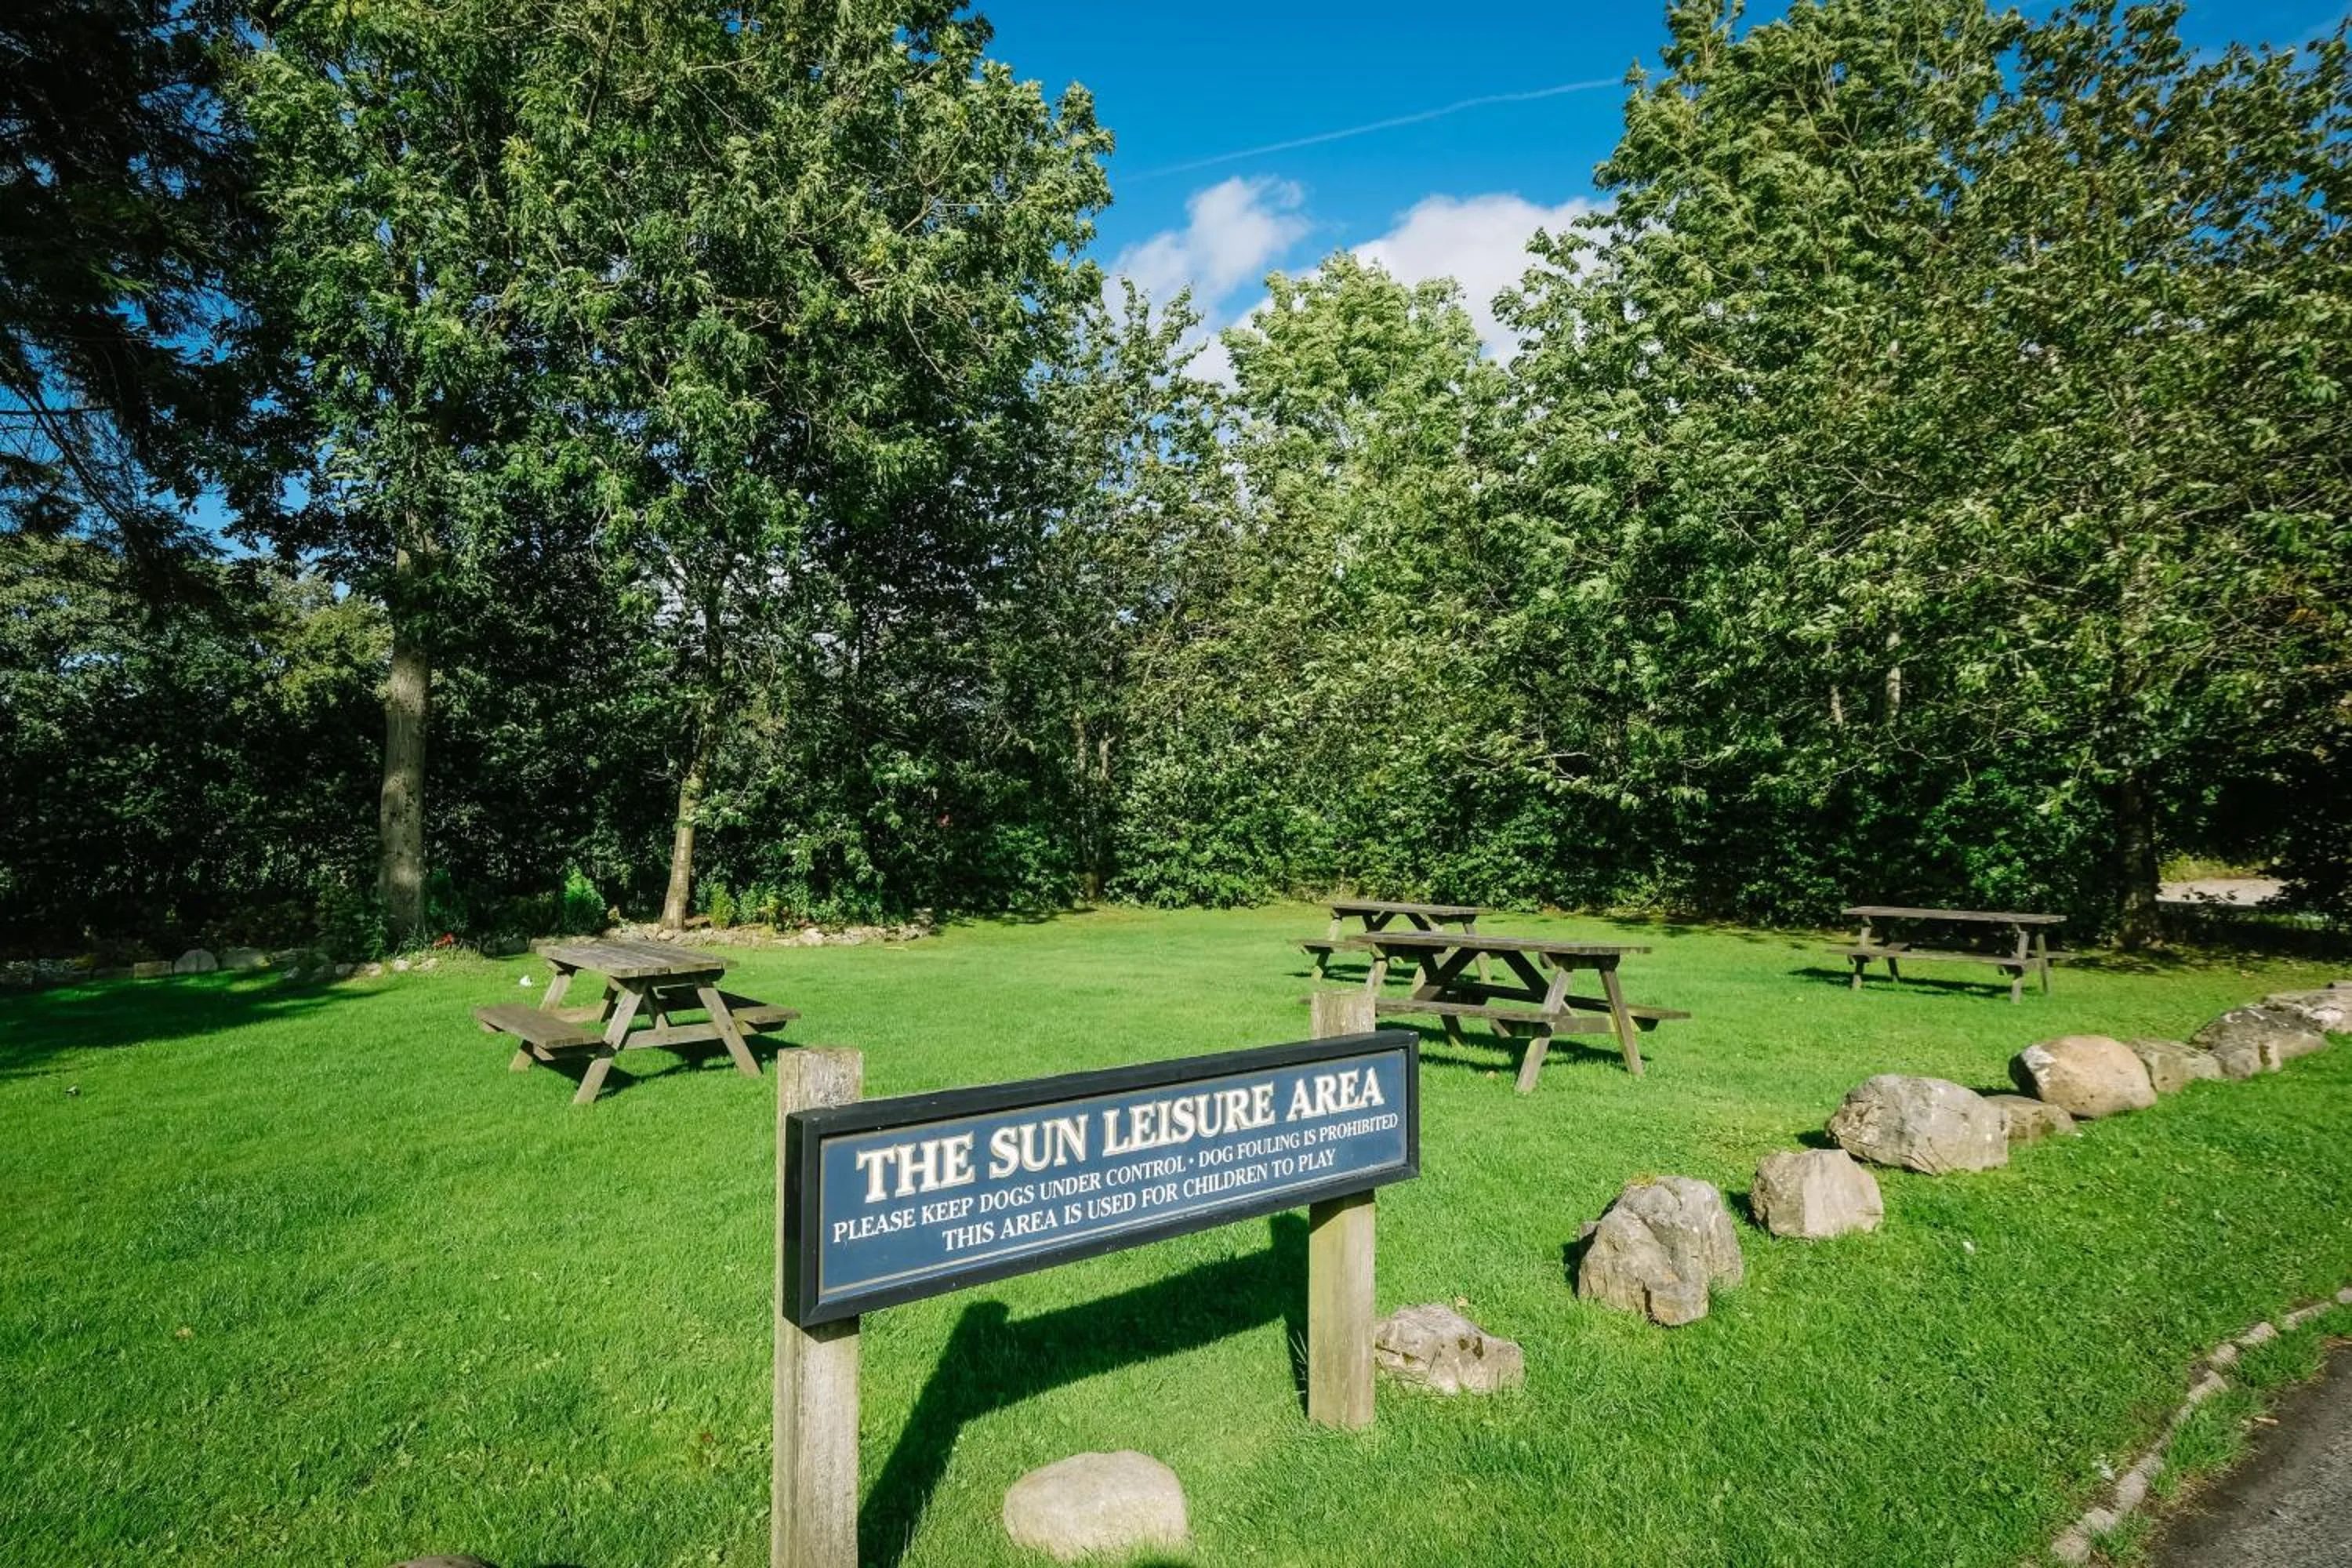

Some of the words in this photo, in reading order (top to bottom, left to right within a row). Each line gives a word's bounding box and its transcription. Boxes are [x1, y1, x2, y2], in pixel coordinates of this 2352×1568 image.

[833, 1208, 916, 1243] PLEASE
[921, 1196, 975, 1225] KEEP
[979, 1185, 1036, 1212] DOGS
[1040, 1172, 1102, 1201] UNDER
[1105, 1156, 1186, 1185] CONTROL
[1198, 1145, 1234, 1168] DOG
[1236, 1133, 1301, 1160] FOULING
[1303, 1128, 1317, 1147] IS
[1319, 1112, 1399, 1142] PROHIBITED
[855, 1131, 975, 1204] THE
[989, 1113, 1089, 1180] SUN
[1102, 1080, 1276, 1157] LEISURE
[1285, 1066, 1386, 1123] AREA
[942, 1222, 996, 1251] THIS
[1000, 1209, 1058, 1239] AREA
[1064, 1203, 1083, 1225] IS
[1087, 1192, 1137, 1219] USED
[1141, 1181, 1180, 1207] FOR
[1182, 1162, 1268, 1198] CHILDREN
[1271, 1157, 1294, 1178] TO
[1298, 1149, 1336, 1173] PLAY
